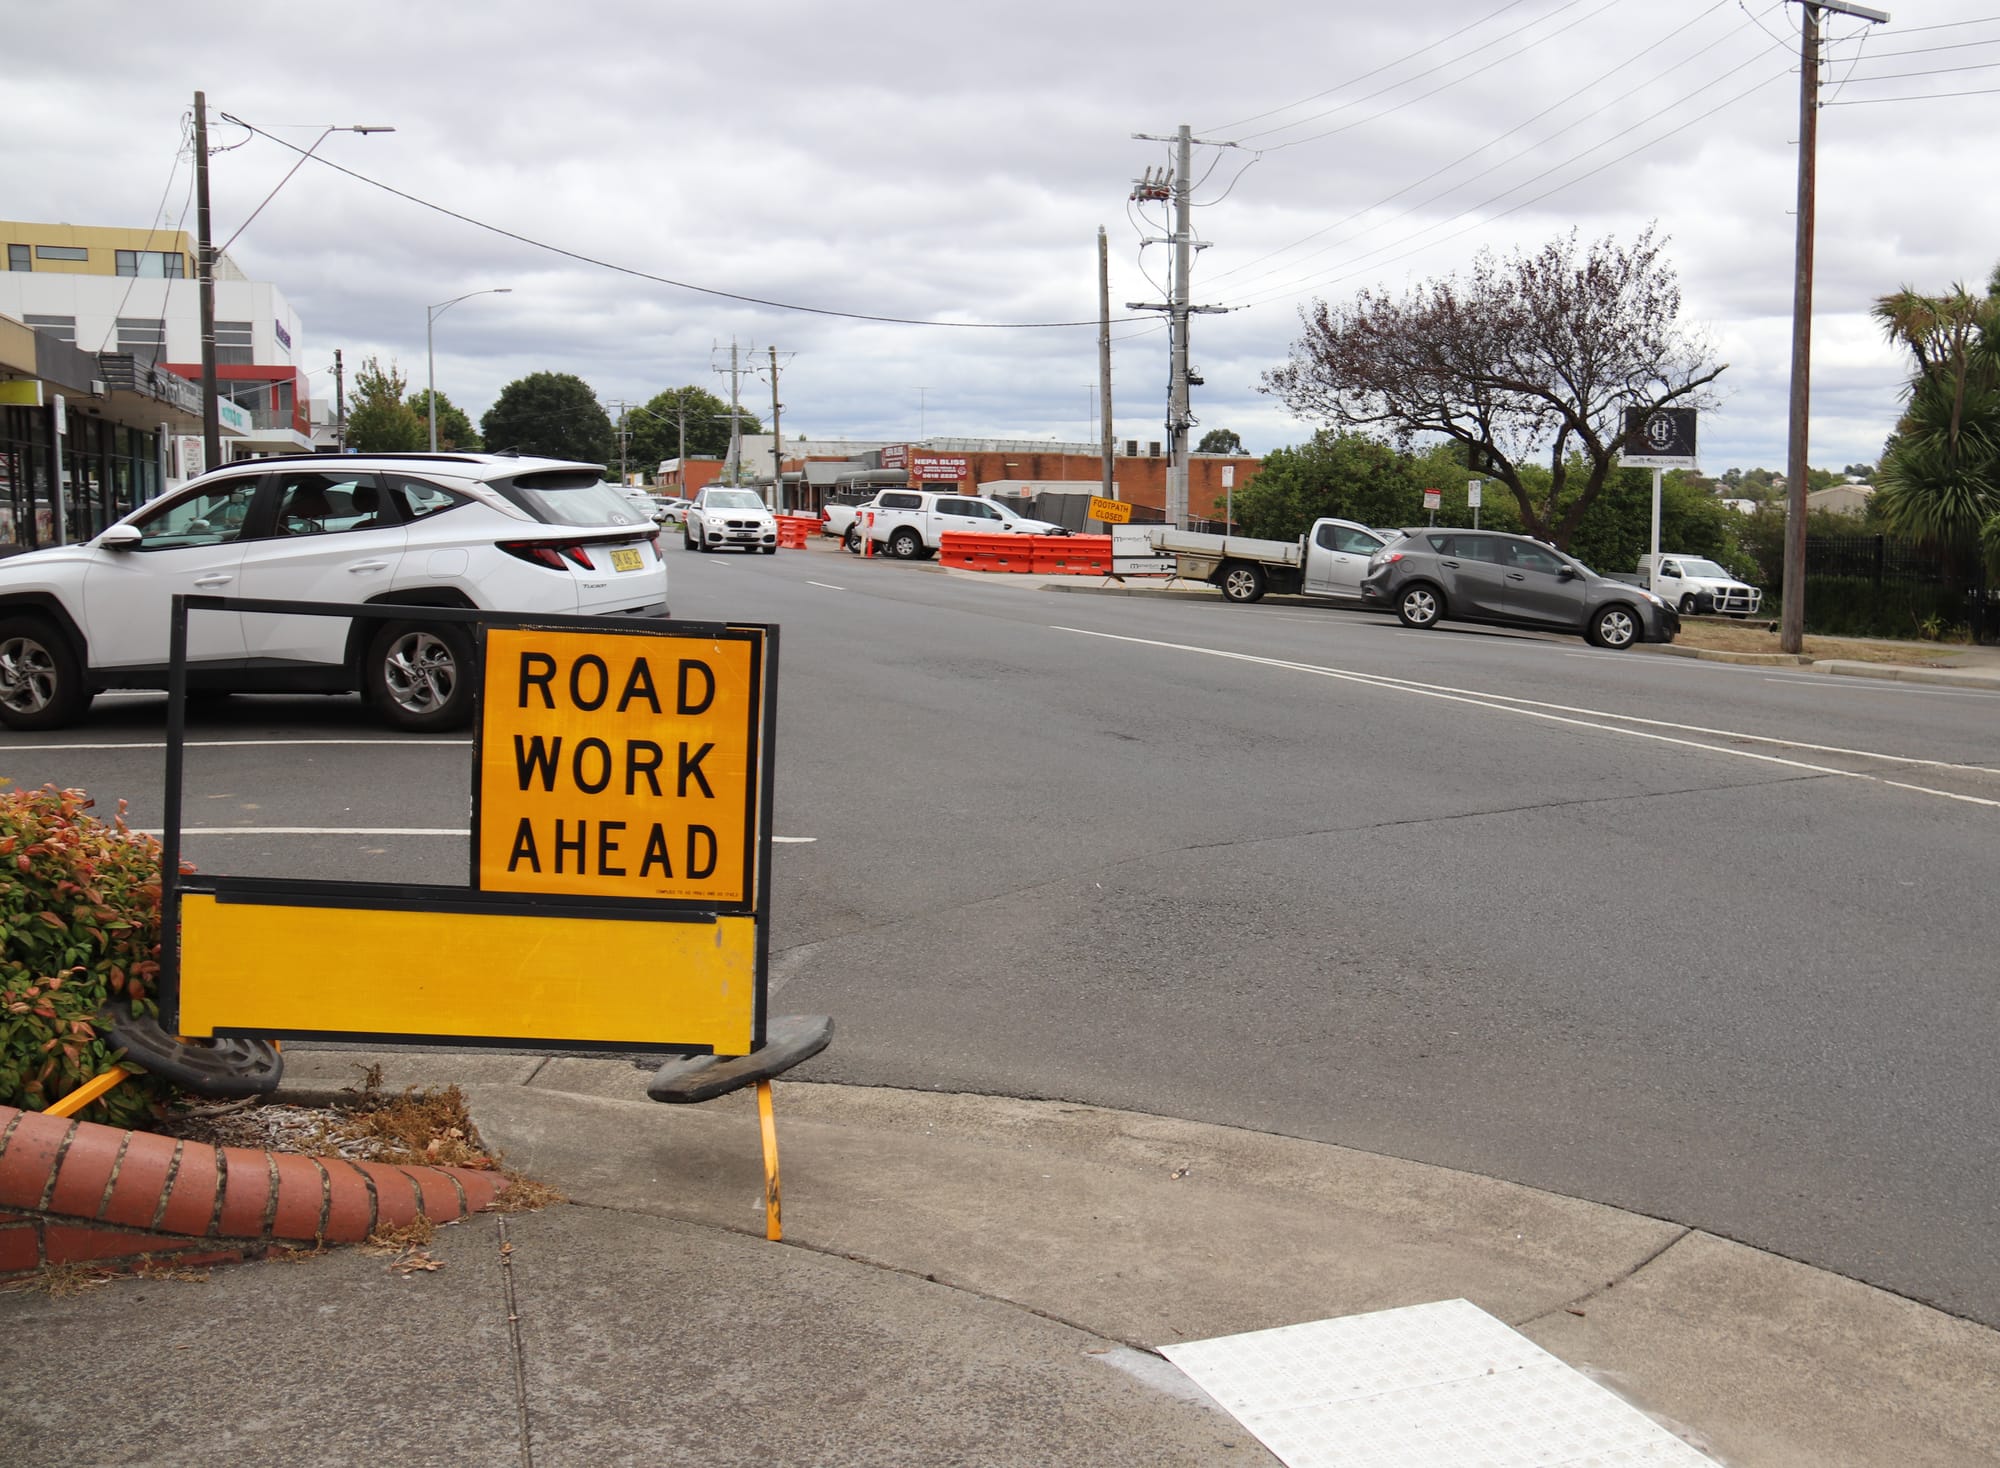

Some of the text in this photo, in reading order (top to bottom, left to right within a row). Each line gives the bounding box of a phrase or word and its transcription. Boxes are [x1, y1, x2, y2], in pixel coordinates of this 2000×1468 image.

[1093, 499, 1129, 513] FOOTPATH
[1096, 510, 1123, 522] CLOSED
[518, 652, 716, 716] ROAD
[514, 734, 716, 799] WORK
[507, 817, 718, 880] AHEAD
